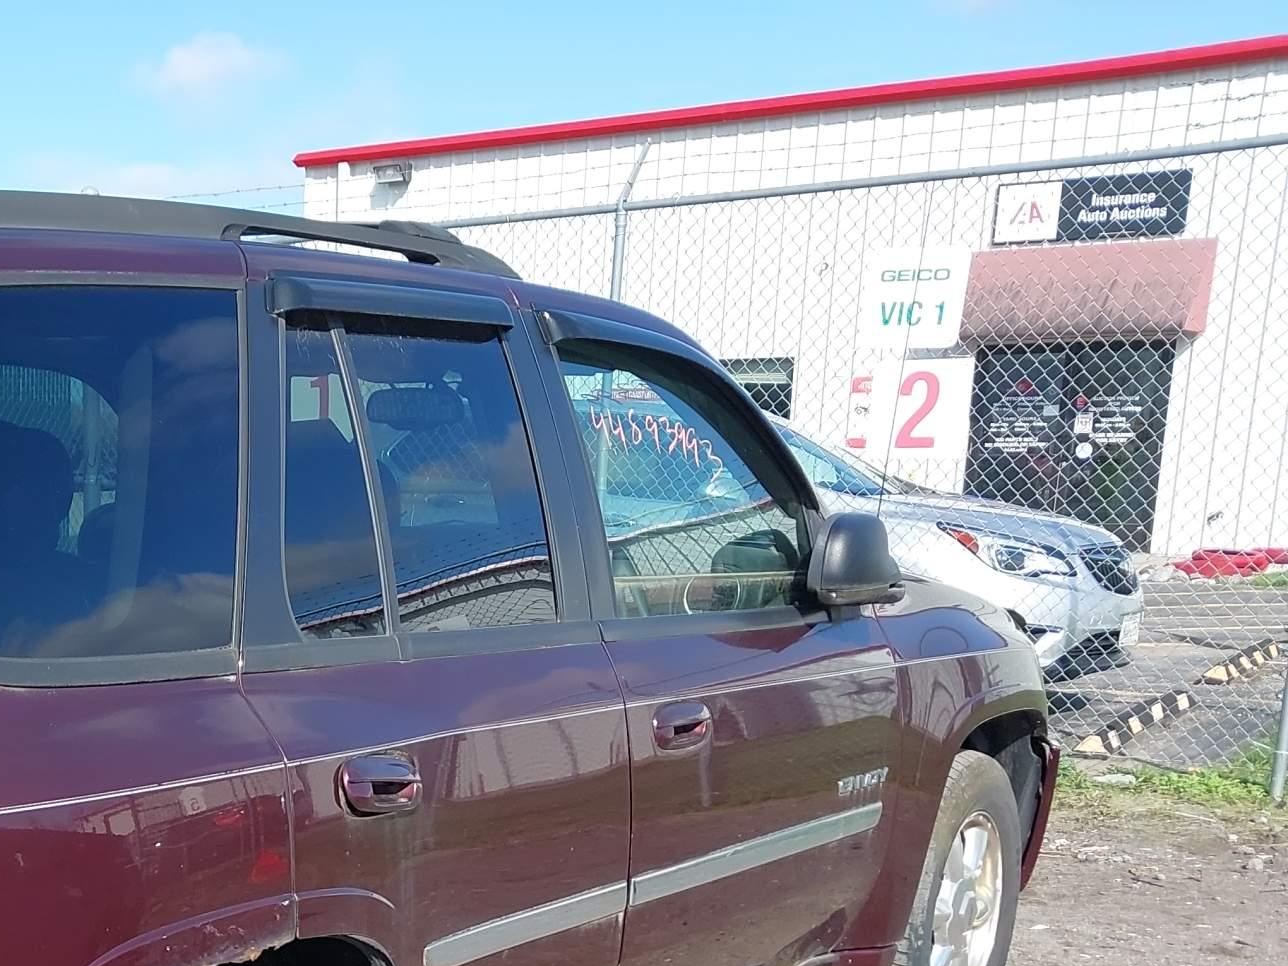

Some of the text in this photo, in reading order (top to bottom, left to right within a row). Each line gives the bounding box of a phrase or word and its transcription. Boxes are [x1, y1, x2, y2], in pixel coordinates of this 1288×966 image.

[1091, 191, 1156, 207] Insurance
[1077, 209, 1108, 223] Auto
[1110, 205, 1168, 221] Auctions
[881, 268, 951, 282] GEICO
[881, 300, 945, 327] VIC 1
[894, 371, 940, 448] 2
